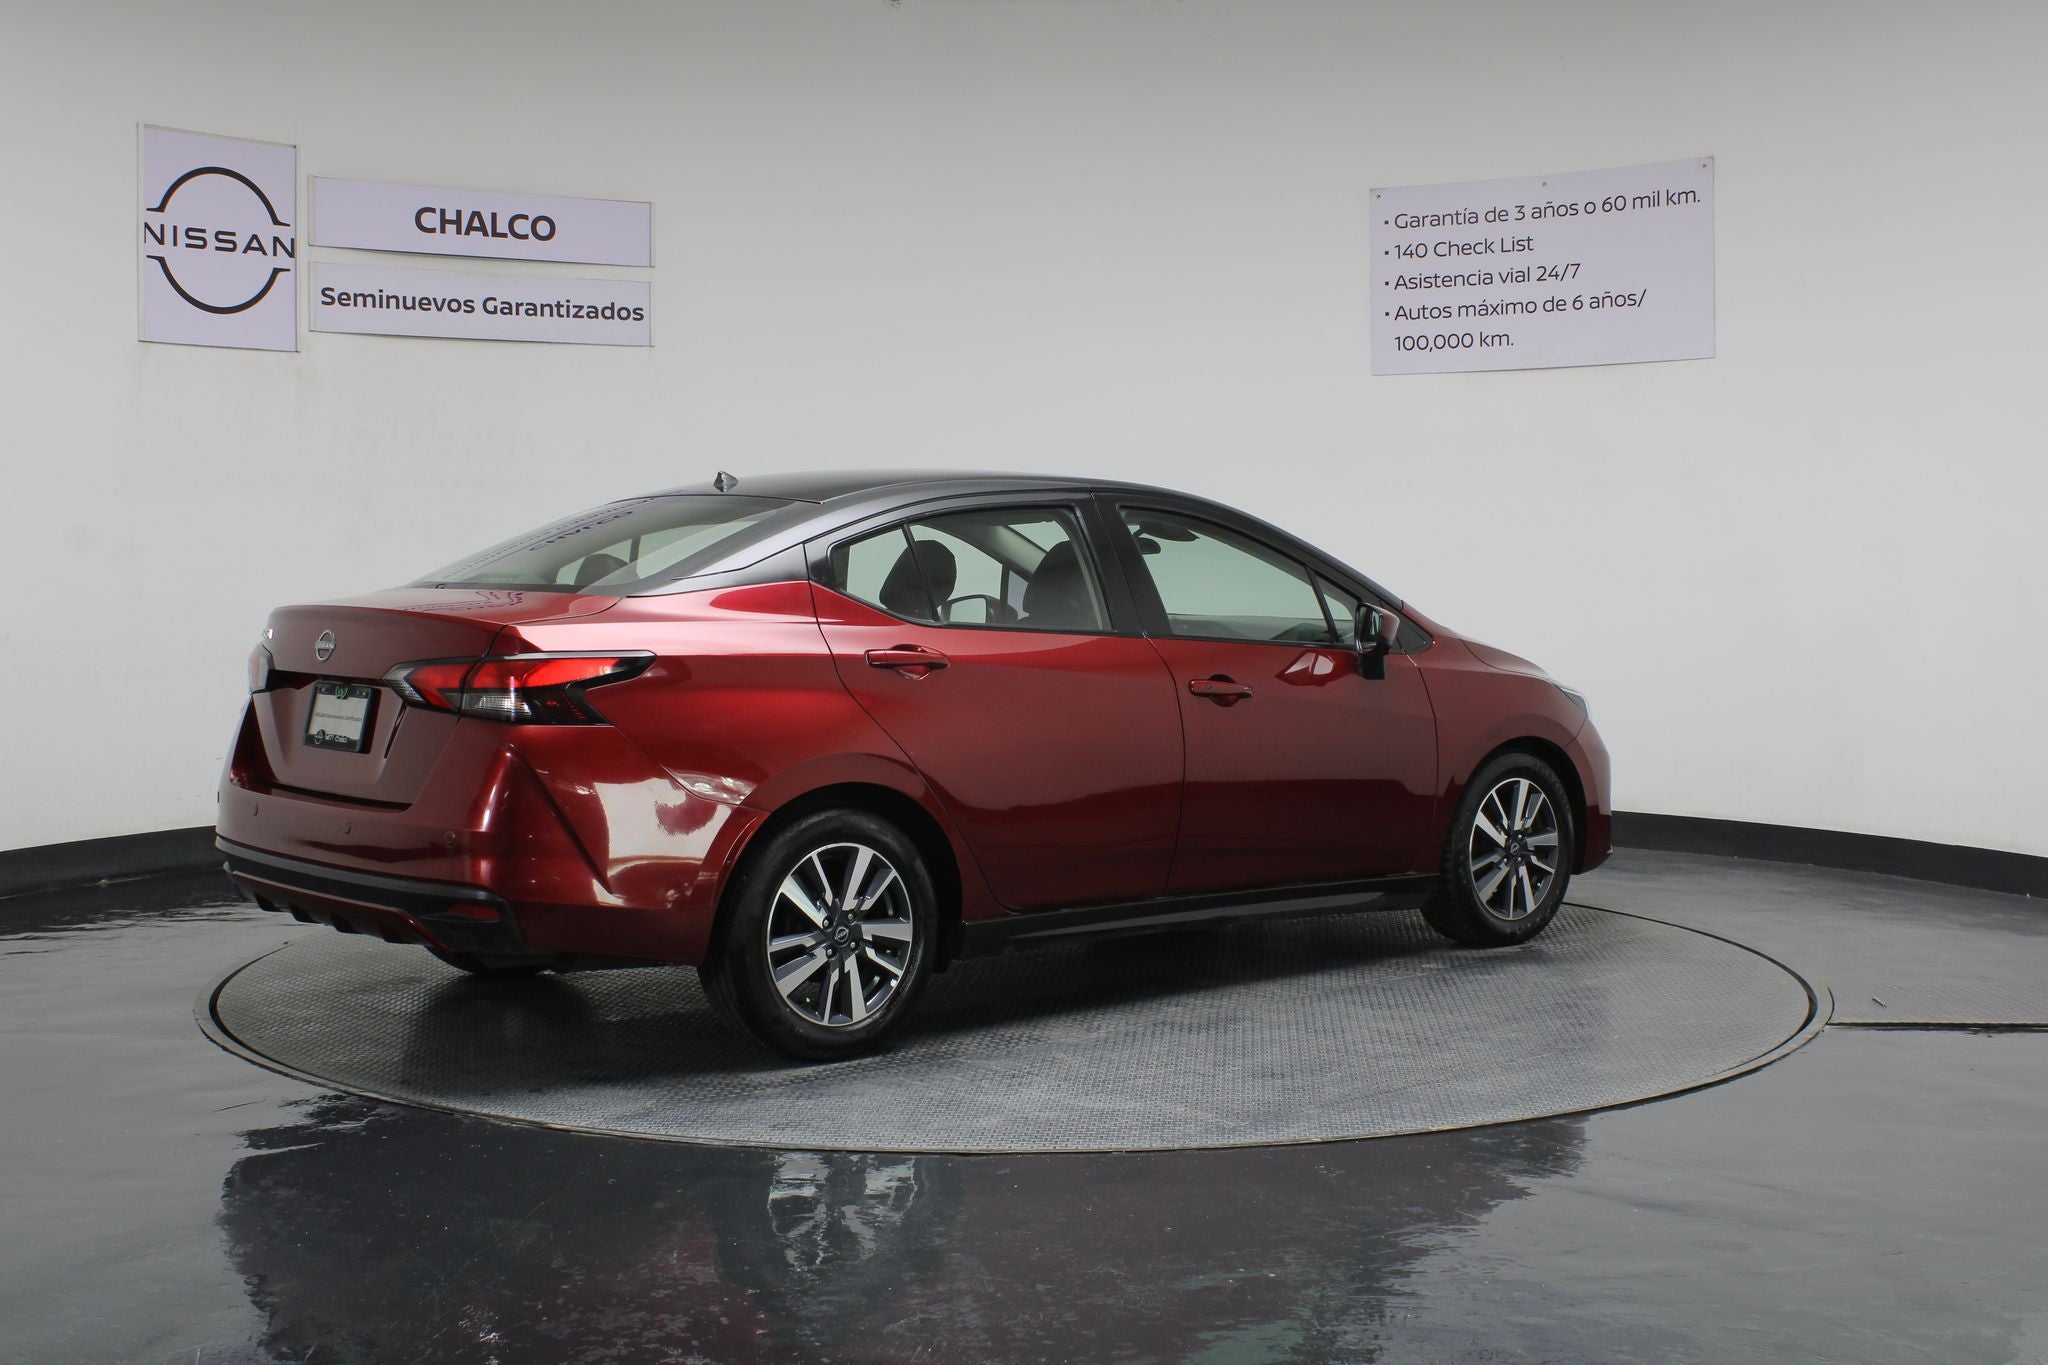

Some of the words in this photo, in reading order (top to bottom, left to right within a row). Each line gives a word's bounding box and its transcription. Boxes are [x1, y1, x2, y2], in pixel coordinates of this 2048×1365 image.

[414, 206, 557, 242] CHALCO
[1394, 207, 1479, 230] Garantía
[1484, 206, 1509, 223] de
[1514, 204, 1526, 221] 3
[1530, 200, 1579, 220] años
[1583, 201, 1597, 215] o
[1601, 194, 1627, 213] 60
[1632, 189, 1661, 210] mil
[1665, 188, 1701, 207] km.
[143, 221, 296, 259] NISSAN
[1394, 242, 1428, 260] 140
[1433, 237, 1496, 258] Check
[1500, 235, 1535, 254] List
[1393, 269, 1494, 291] Asistencia
[1498, 265, 1531, 284] vial
[1536, 262, 1581, 282] 24/7
[320, 286, 476, 314] Seminuevos
[482, 296, 645, 322] Garantizados
[1394, 304, 1453, 321] Autos
[1457, 298, 1538, 318] máximo
[1542, 295, 1567, 313] de
[1572, 294, 1584, 311] 6
[1589, 288, 1647, 310] años/
[1394, 332, 1474, 353] 100,000
[1479, 331, 1514, 348] km.
